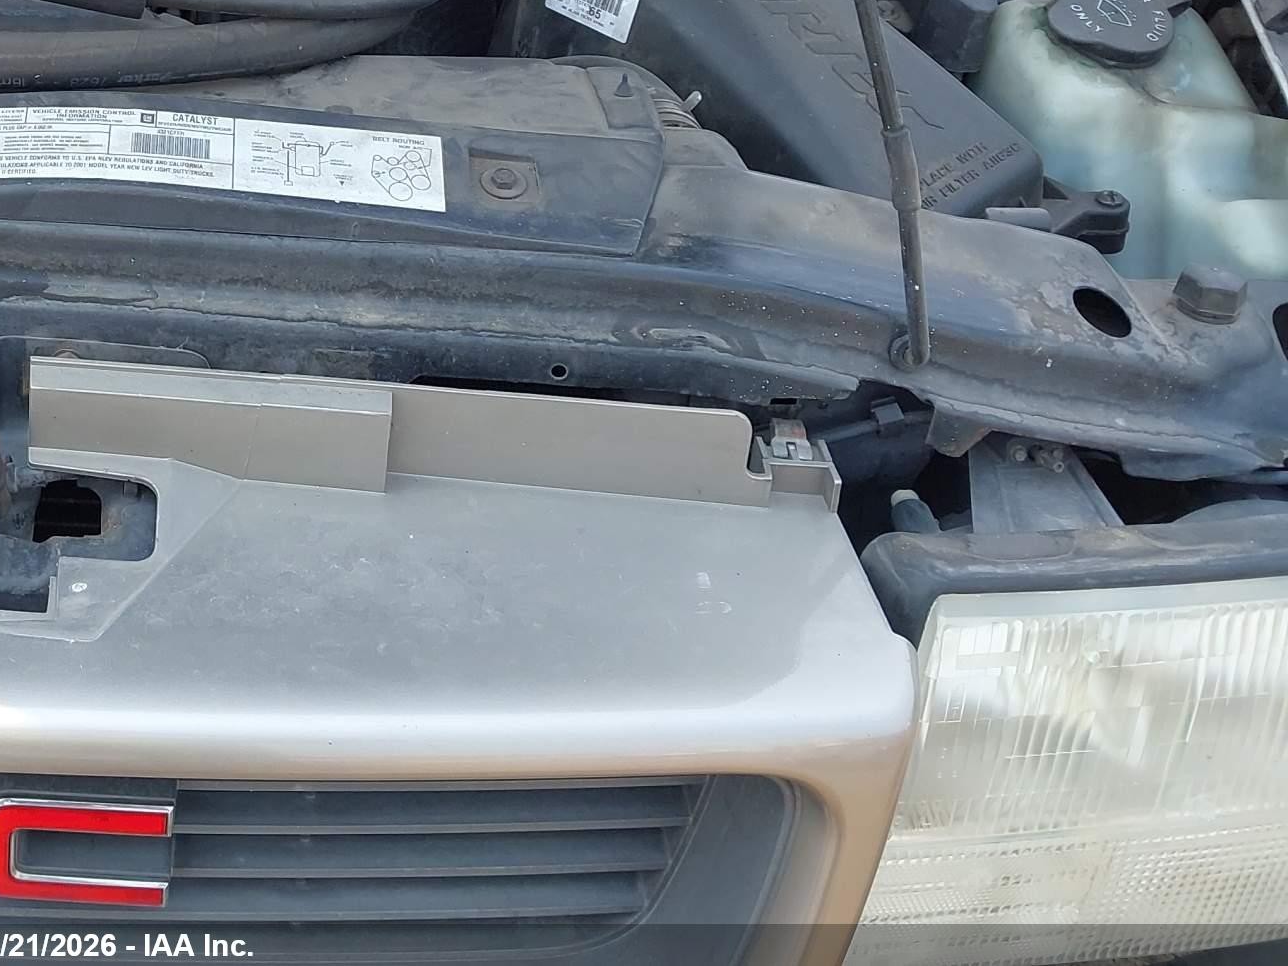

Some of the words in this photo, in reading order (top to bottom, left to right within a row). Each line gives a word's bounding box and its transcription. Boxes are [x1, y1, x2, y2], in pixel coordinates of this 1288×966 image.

[1069, 4, 1105, 33] ONLY
[1145, 9, 1167, 42] FLUID
[172, 113, 219, 126] CATALYST
[392, 137, 425, 146] ROUTING
[169, 160, 204, 170] CALIFORNIA
